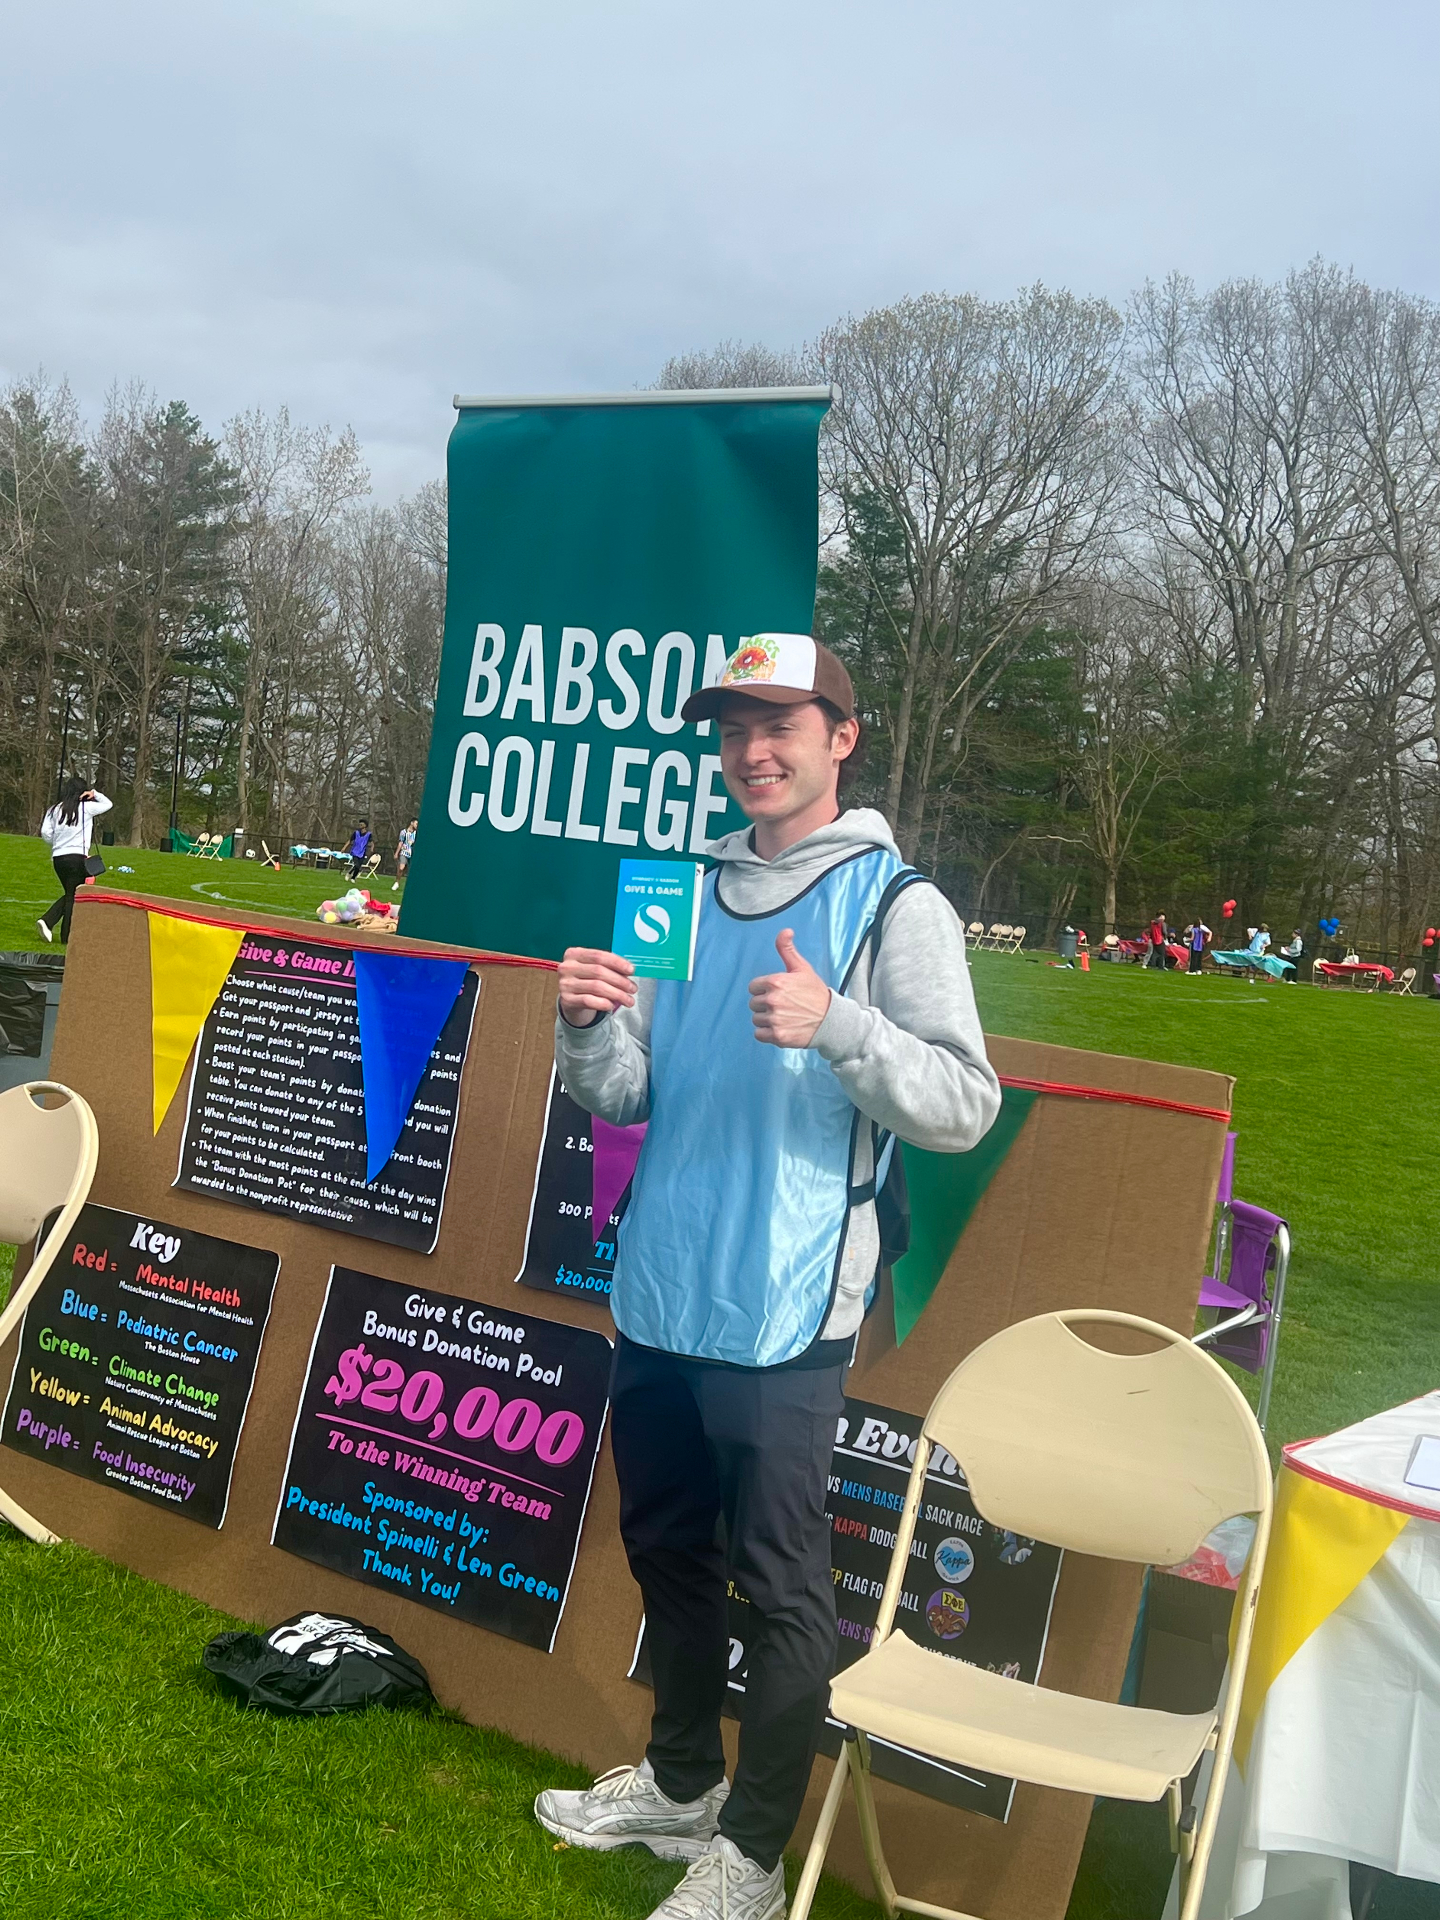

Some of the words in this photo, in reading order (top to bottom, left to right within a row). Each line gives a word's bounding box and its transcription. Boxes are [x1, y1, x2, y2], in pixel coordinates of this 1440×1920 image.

[447, 731, 728, 854] COLLEGE
[624, 884, 646, 894] GIVE
[647, 886, 654, 894] &
[656, 886, 684, 896] GAME
[273, 949, 290, 968] &
[290, 950, 342, 974] Game
[222, 991, 237, 1002] Get
[238, 997, 258, 1007] your
[258, 1000, 293, 1013] passport
[294, 1006, 311, 1016] and
[313, 1008, 341, 1025] jersey
[226, 974, 255, 988] Choose
[256, 980, 276, 992] what
[278, 986, 325, 1001] cause/team
[327, 996, 342, 1006] you
[213, 1044, 241, 1054] posted
[252, 1050, 270, 1059] each
[216, 1026, 244, 1037] record
[246, 1033, 264, 1042] your
[267, 1036, 292, 1047] points
[308, 1045, 329, 1055] your
[430, 1069, 457, 1081] points
[219, 1007, 239, 1019] Earn
[242, 1014, 266, 1025] points
[269, 1016, 280, 1030] by
[282, 1022, 333, 1041] particpating
[444, 1052, 461, 1062] and
[206, 1092, 234, 1104] receive
[234, 1099, 257, 1110] points
[259, 1103, 289, 1117] toward
[289, 1112, 309, 1122] your
[312, 1114, 335, 1127] team.
[210, 1074, 230, 1086] table.
[234, 1078, 247, 1090] You
[249, 1084, 262, 1093] can
[265, 1086, 293, 1100] donate
[307, 1097, 324, 1110] any
[340, 1101, 354, 1113] the
[415, 1122, 431, 1132] you
[434, 1124, 448, 1134] will
[212, 1056, 234, 1070] Boost
[238, 1066, 256, 1075] your
[260, 1068, 285, 1081] team's
[289, 1076, 316, 1088] points
[321, 1079, 332, 1094] by
[414, 1099, 450, 1116] donation
[201, 1123, 213, 1134] for
[213, 1129, 231, 1139] your
[232, 1133, 256, 1145] points
[279, 1144, 324, 1160] calculated.
[204, 1106, 224, 1119] When
[227, 1112, 258, 1129] finished,
[262, 1121, 279, 1132] turn
[292, 1130, 312, 1140] your
[314, 1136, 354, 1149] passport
[417, 1154, 441, 1169] booth
[564, 1136, 576, 1150] 2.
[195, 1156, 207, 1167] the
[238, 1167, 273, 1184] Donation
[300, 1182, 315, 1194] for
[319, 1187, 339, 1200] their
[344, 1196, 370, 1209] cause,
[375, 1201, 399, 1214] which
[404, 1210, 418, 1220] will
[199, 1140, 212, 1151] The
[214, 1144, 232, 1156] team
[235, 1150, 251, 1160] with
[254, 1153, 266, 1165] the
[268, 1160, 289, 1170] most
[290, 1165, 318, 1177] points
[334, 1172, 347, 1184] the
[350, 1178, 366, 1188] end
[381, 1184, 395, 1195] the
[398, 1188, 414, 1204] day
[417, 1195, 436, 1206] wins
[191, 1175, 225, 1189] awarded
[236, 1184, 248, 1195] the
[249, 1191, 288, 1206] nonprofit
[290, 1200, 353, 1222] representative.
[558, 1202, 582, 1217] 300
[129, 1222, 180, 1263] Key
[72, 1243, 107, 1271] Red
[136, 1264, 189, 1293] Mental
[191, 1280, 240, 1307] Health
[554, 1264, 612, 1294] $20,000
[60, 1289, 98, 1320] Blue
[117, 1310, 179, 1344] Pediatric
[183, 1330, 238, 1362] Cancer
[159, 1292, 195, 1309] Association
[208, 1306, 231, 1319] Mental
[232, 1313, 253, 1325] Health
[405, 1294, 446, 1322] Give
[452, 1305, 463, 1328] &
[468, 1310, 524, 1343] Game
[39, 1327, 89, 1361] Green
[109, 1355, 161, 1387] Climate
[165, 1374, 219, 1409] Change
[145, 1341, 156, 1351] The
[157, 1344, 179, 1358] Boston
[180, 1352, 200, 1364] House
[363, 1310, 417, 1346] Bonus
[422, 1329, 509, 1371] Donation
[516, 1353, 562, 1386] Pool
[30, 1368, 81, 1406] Yellow
[100, 1397, 146, 1427] Animal
[149, 1414, 218, 1458] Advocacy
[105, 1377, 125, 1389] Nature
[126, 1384, 164, 1405] Conservancy
[324, 1344, 584, 1464] $20,000
[17, 1409, 71, 1448] Purple
[93, 1442, 122, 1467] Food
[125, 1455, 195, 1499] Insecurity
[106, 1419, 126, 1432] Animal
[148, 1434, 170, 1448] League
[179, 1444, 200, 1458] Boston
[106, 1467, 129, 1482] Greater
[129, 1475, 150, 1490] Boston
[151, 1484, 167, 1496] Food
[166, 1489, 181, 1502] Bank
[328, 1430, 353, 1454] To
[355, 1441, 389, 1465] the
[395, 1452, 486, 1502] Winning
[488, 1482, 551, 1520] Team
[362, 1481, 456, 1531] Sponsored
[459, 1513, 489, 1548] by:
[826, 1474, 840, 1493] VS
[842, 1480, 872, 1502] MENS
[873, 1488, 923, 1519] BASEL
[926, 1504, 954, 1528] SACK
[954, 1514, 985, 1536] RACE
[286, 1486, 372, 1534] President
[377, 1519, 439, 1558] Spinelli
[443, 1543, 454, 1565] &
[457, 1546, 492, 1577] Len
[498, 1563, 558, 1601] Green
[834, 1516, 868, 1540] KAPPA
[869, 1526, 928, 1560] DODGALL
[935, 1550, 971, 1568] Kappa
[363, 1549, 411, 1585] Thank
[421, 1568, 460, 1604] You!
[842, 1572, 868, 1594] FLAG
[870, 1580, 918, 1612] FOBALL
